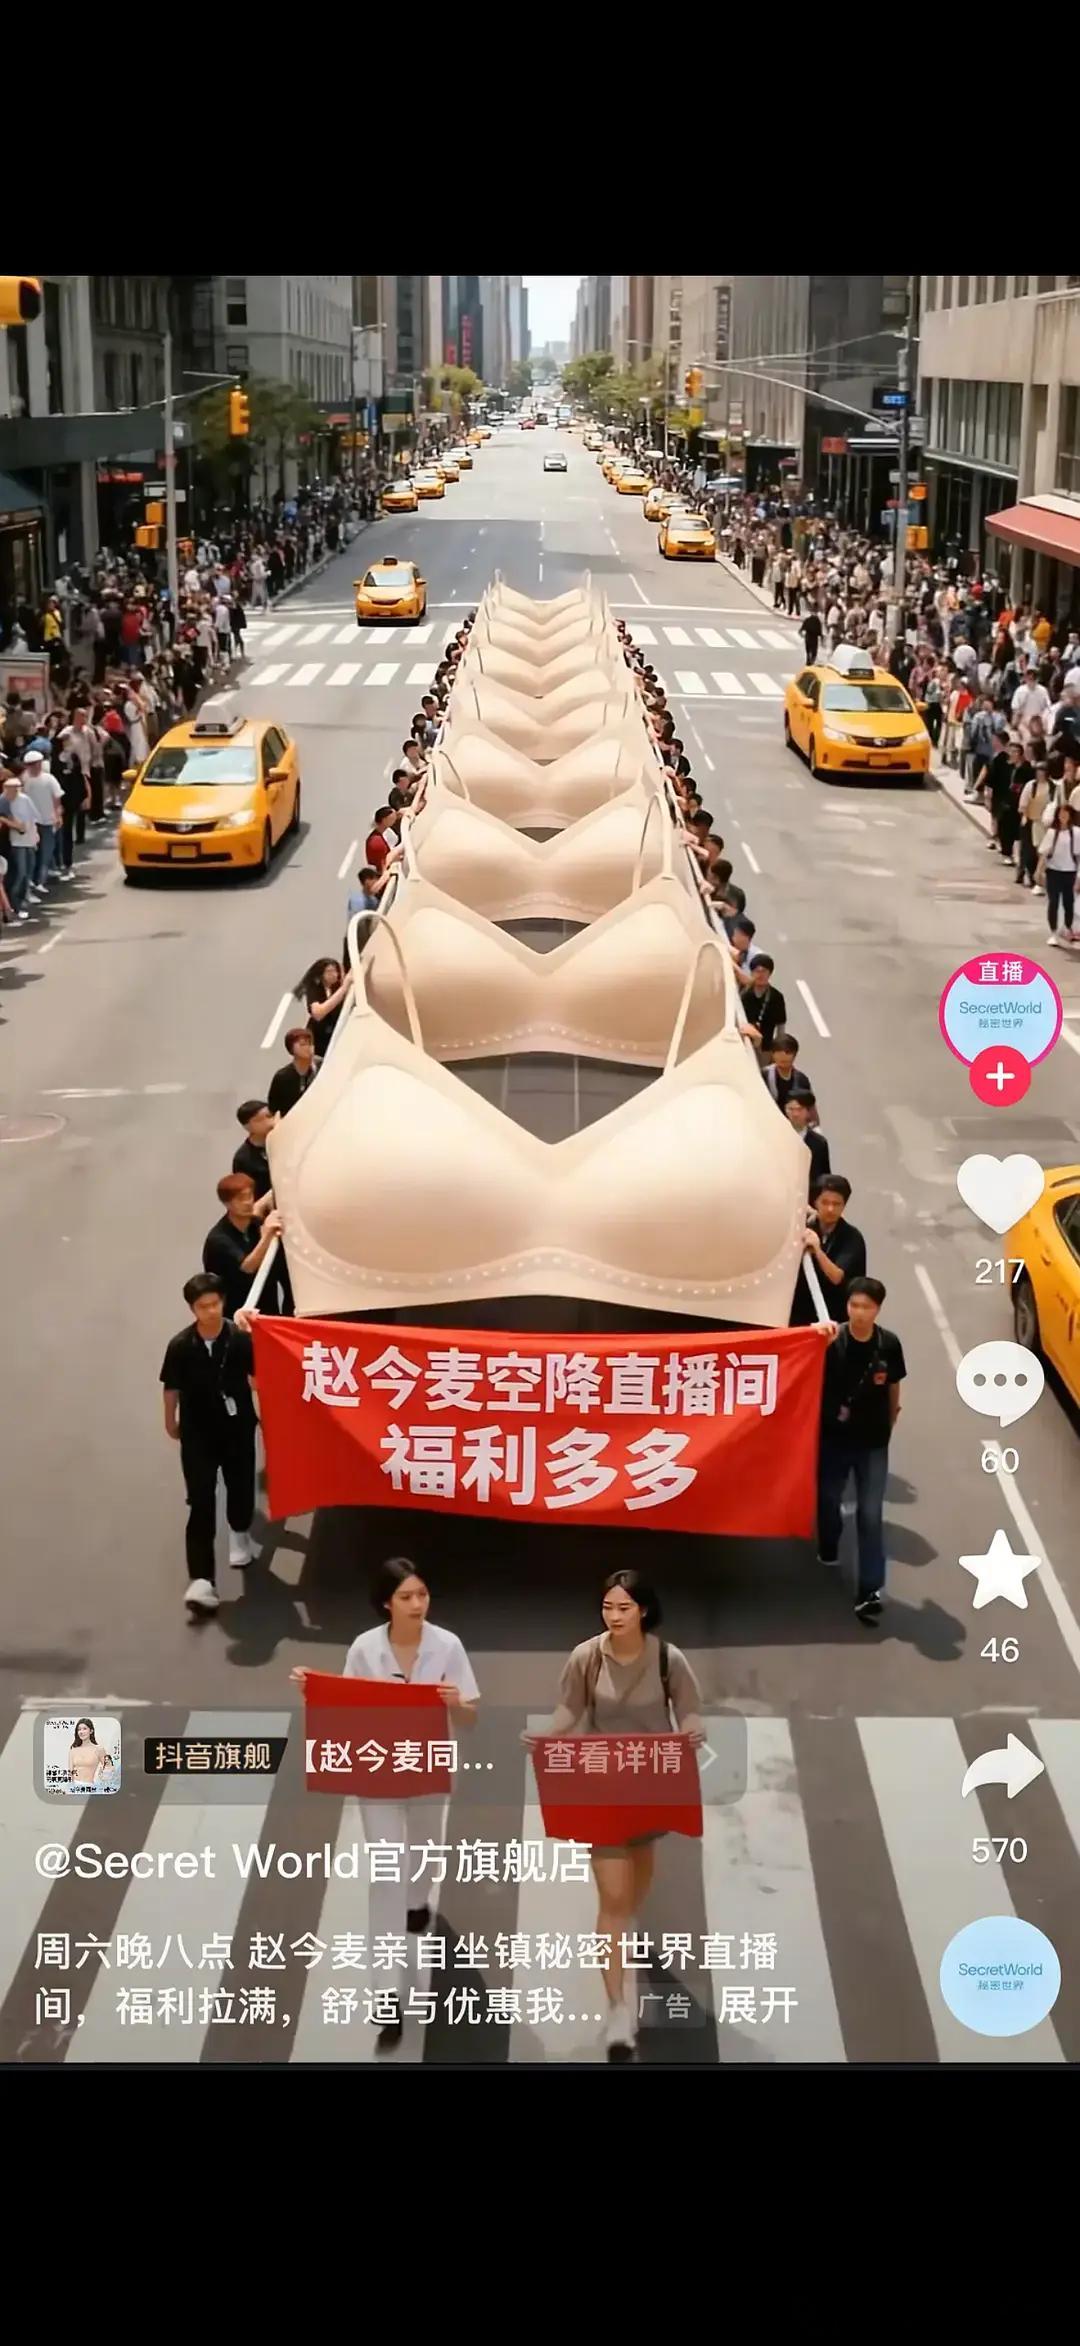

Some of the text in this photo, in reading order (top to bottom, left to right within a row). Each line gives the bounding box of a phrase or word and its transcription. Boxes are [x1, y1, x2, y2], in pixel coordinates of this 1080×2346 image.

[301, 1340, 778, 1418] 赵今麦空降直播间
[379, 1424, 699, 1511] 福利多多
